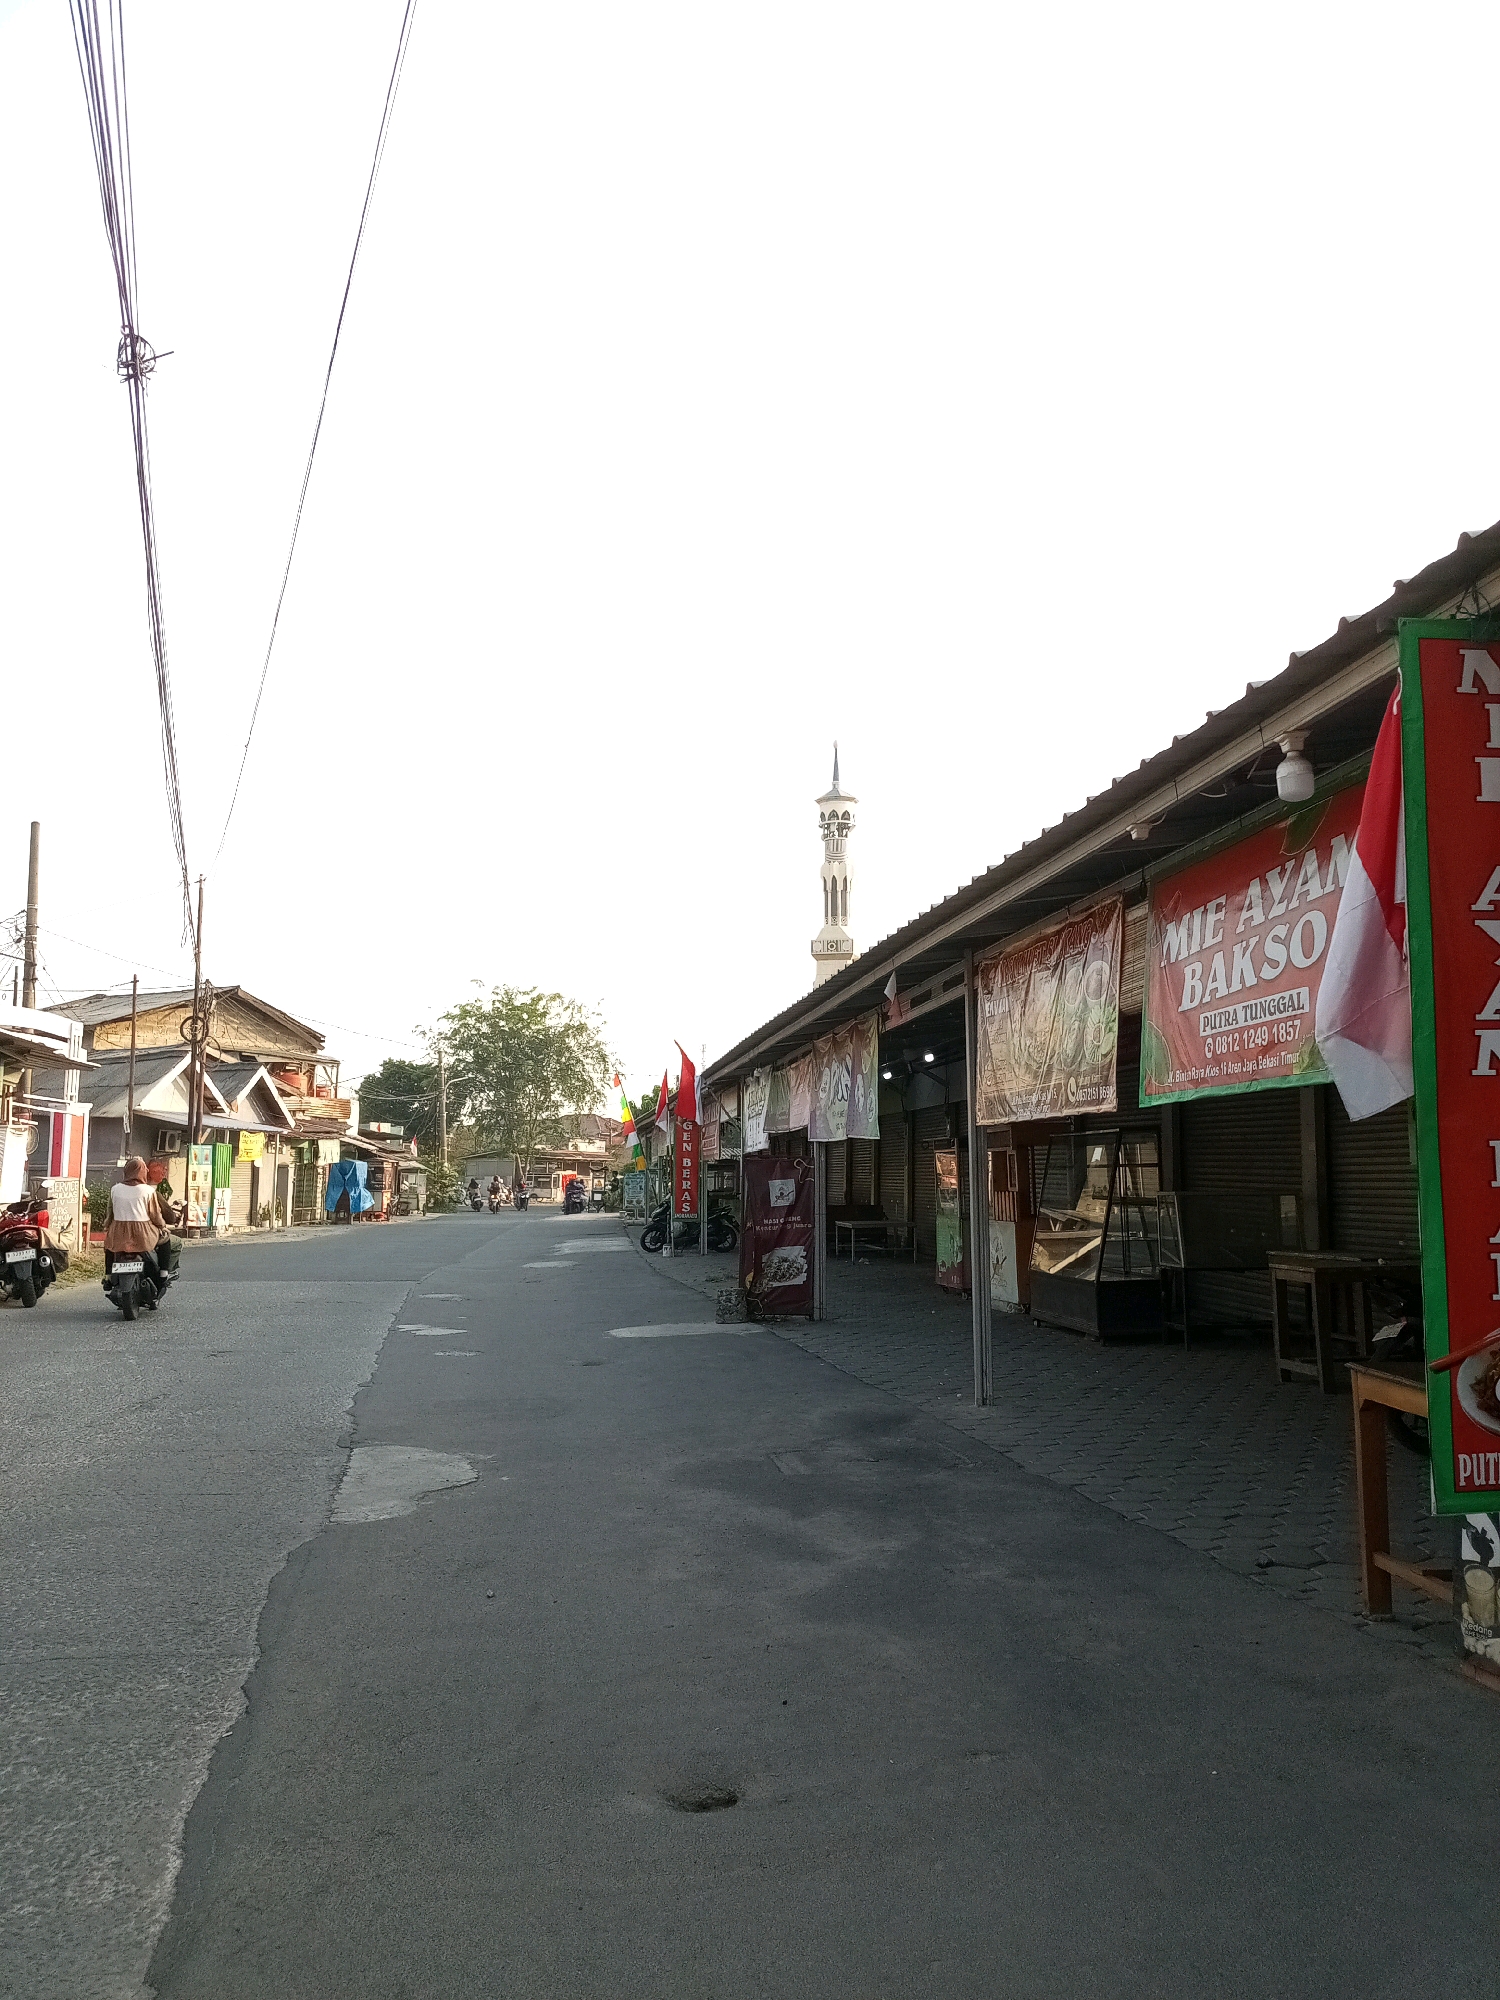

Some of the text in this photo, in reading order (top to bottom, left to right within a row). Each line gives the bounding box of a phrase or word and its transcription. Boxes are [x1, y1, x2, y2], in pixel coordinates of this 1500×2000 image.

[1160, 894, 1227, 967] MIE
[1178, 910, 1328, 1013] BAKSO
[1202, 991, 1305, 1033] PUTRA TUNGGAL
[1216, 1020, 1300, 1055] 0812 1249 1857
[1205, 1064, 1220, 1078] Kios
[1227, 1061, 1242, 1074] Aren
[1242, 1058, 1257, 1075] Jaya
[1258, 1053, 1280, 1070] Bekasi
[1281, 1050, 1301, 1066] Timur
[681, 1158, 692, 1212] BERAS
[1458, 1451, 1500, 1486] PUT
